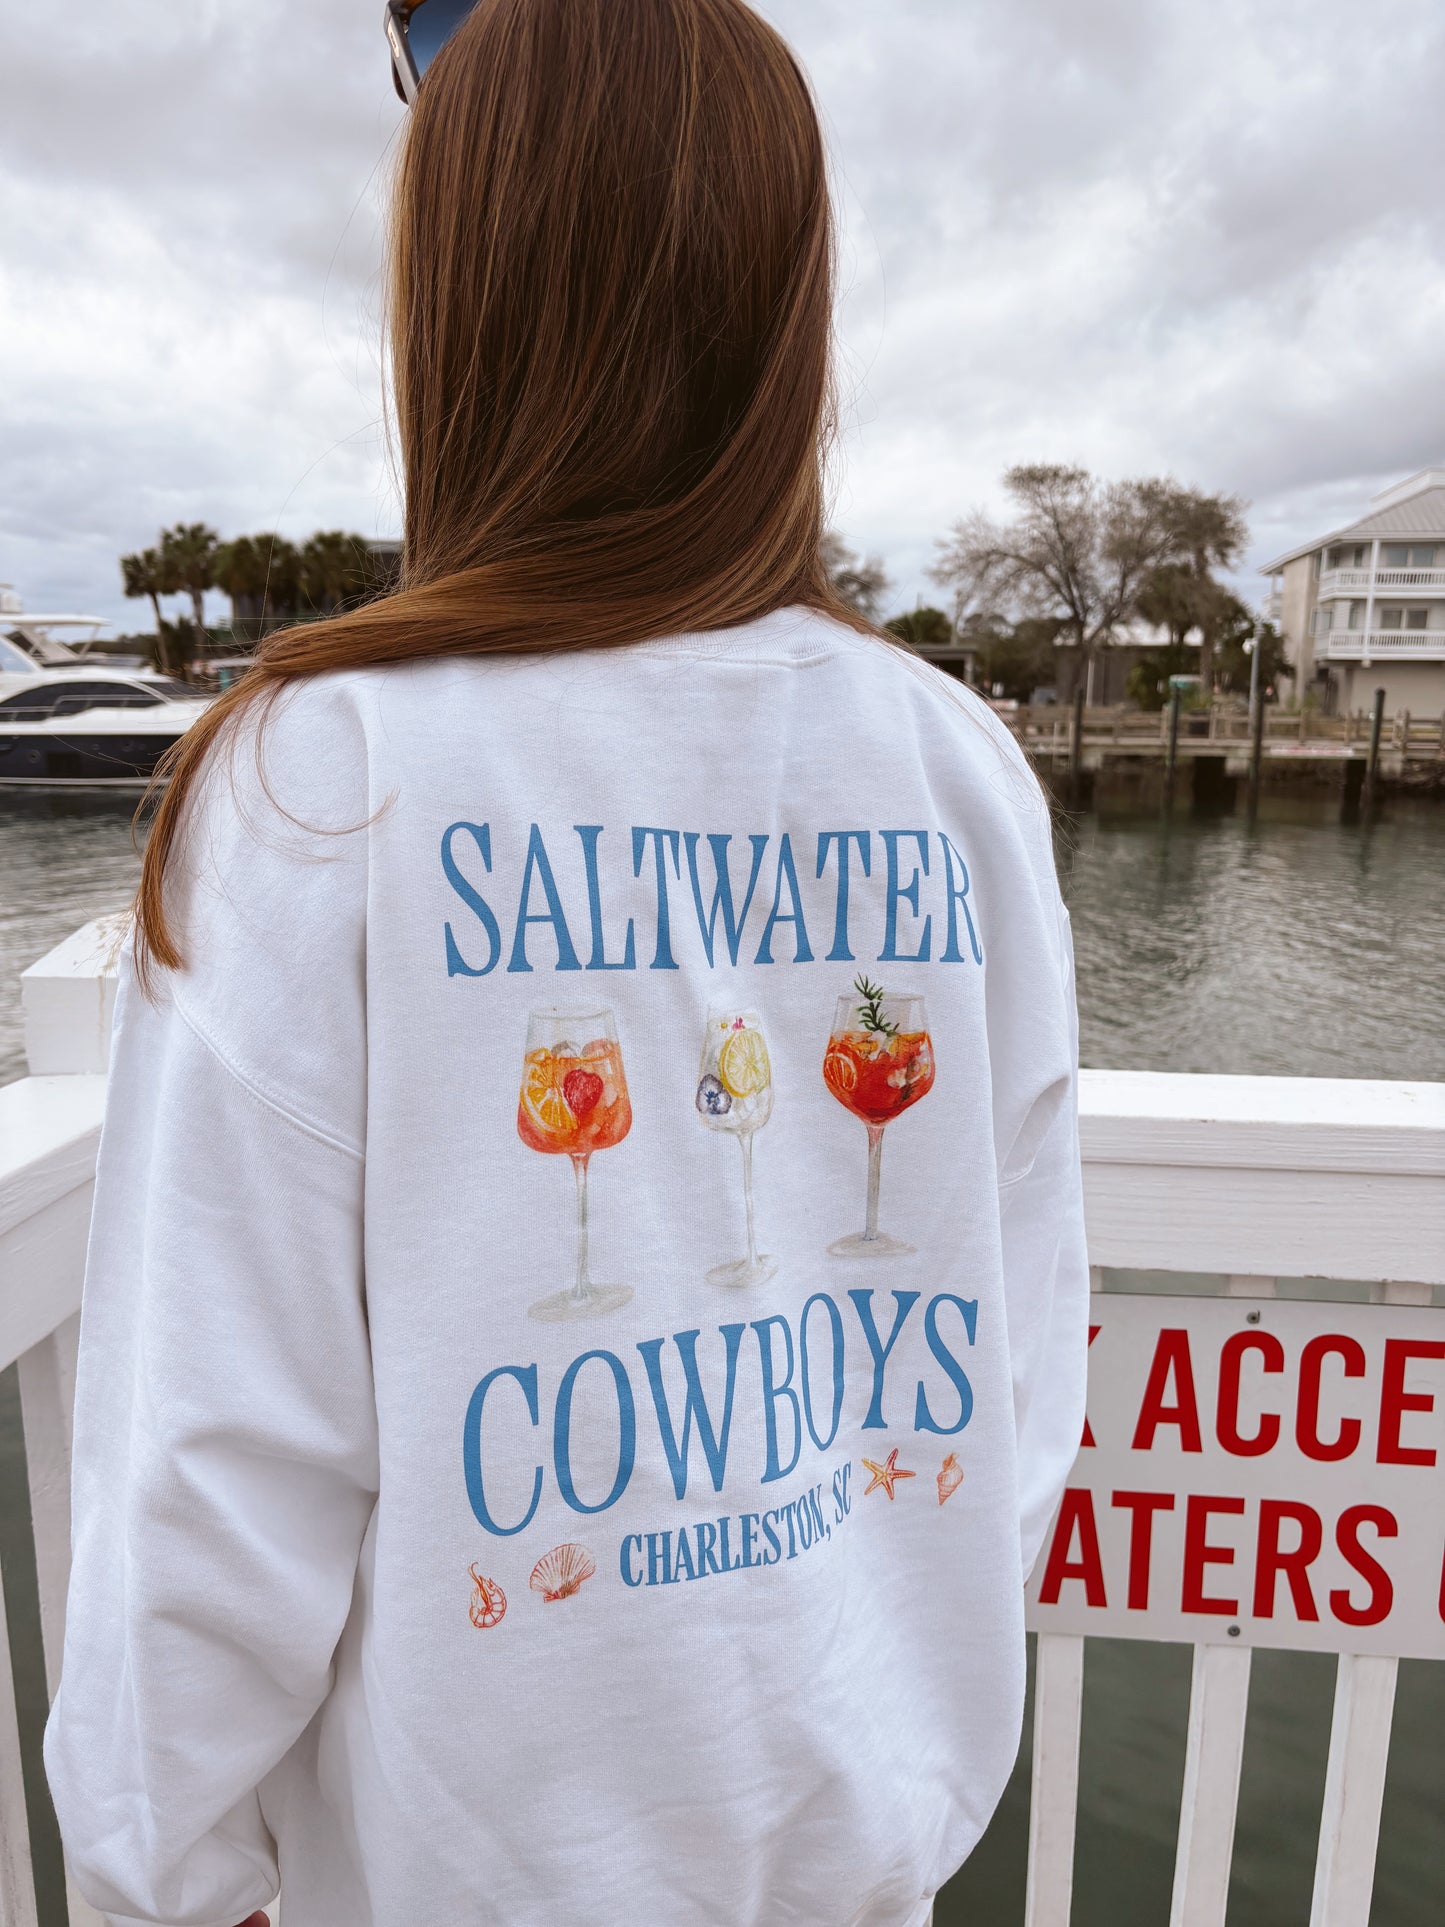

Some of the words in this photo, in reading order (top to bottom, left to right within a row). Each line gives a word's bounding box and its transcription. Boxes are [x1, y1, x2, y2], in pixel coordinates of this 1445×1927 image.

[440, 821, 982, 977] SALTWATER
[463, 1289, 978, 1536] COWBOYS
[1131, 1328, 1445, 1467] ACCE
[619, 1483, 831, 1587] CHARLESTON,
[832, 1462, 852, 1525] SC
[1024, 1487, 1399, 1627] ATERS
